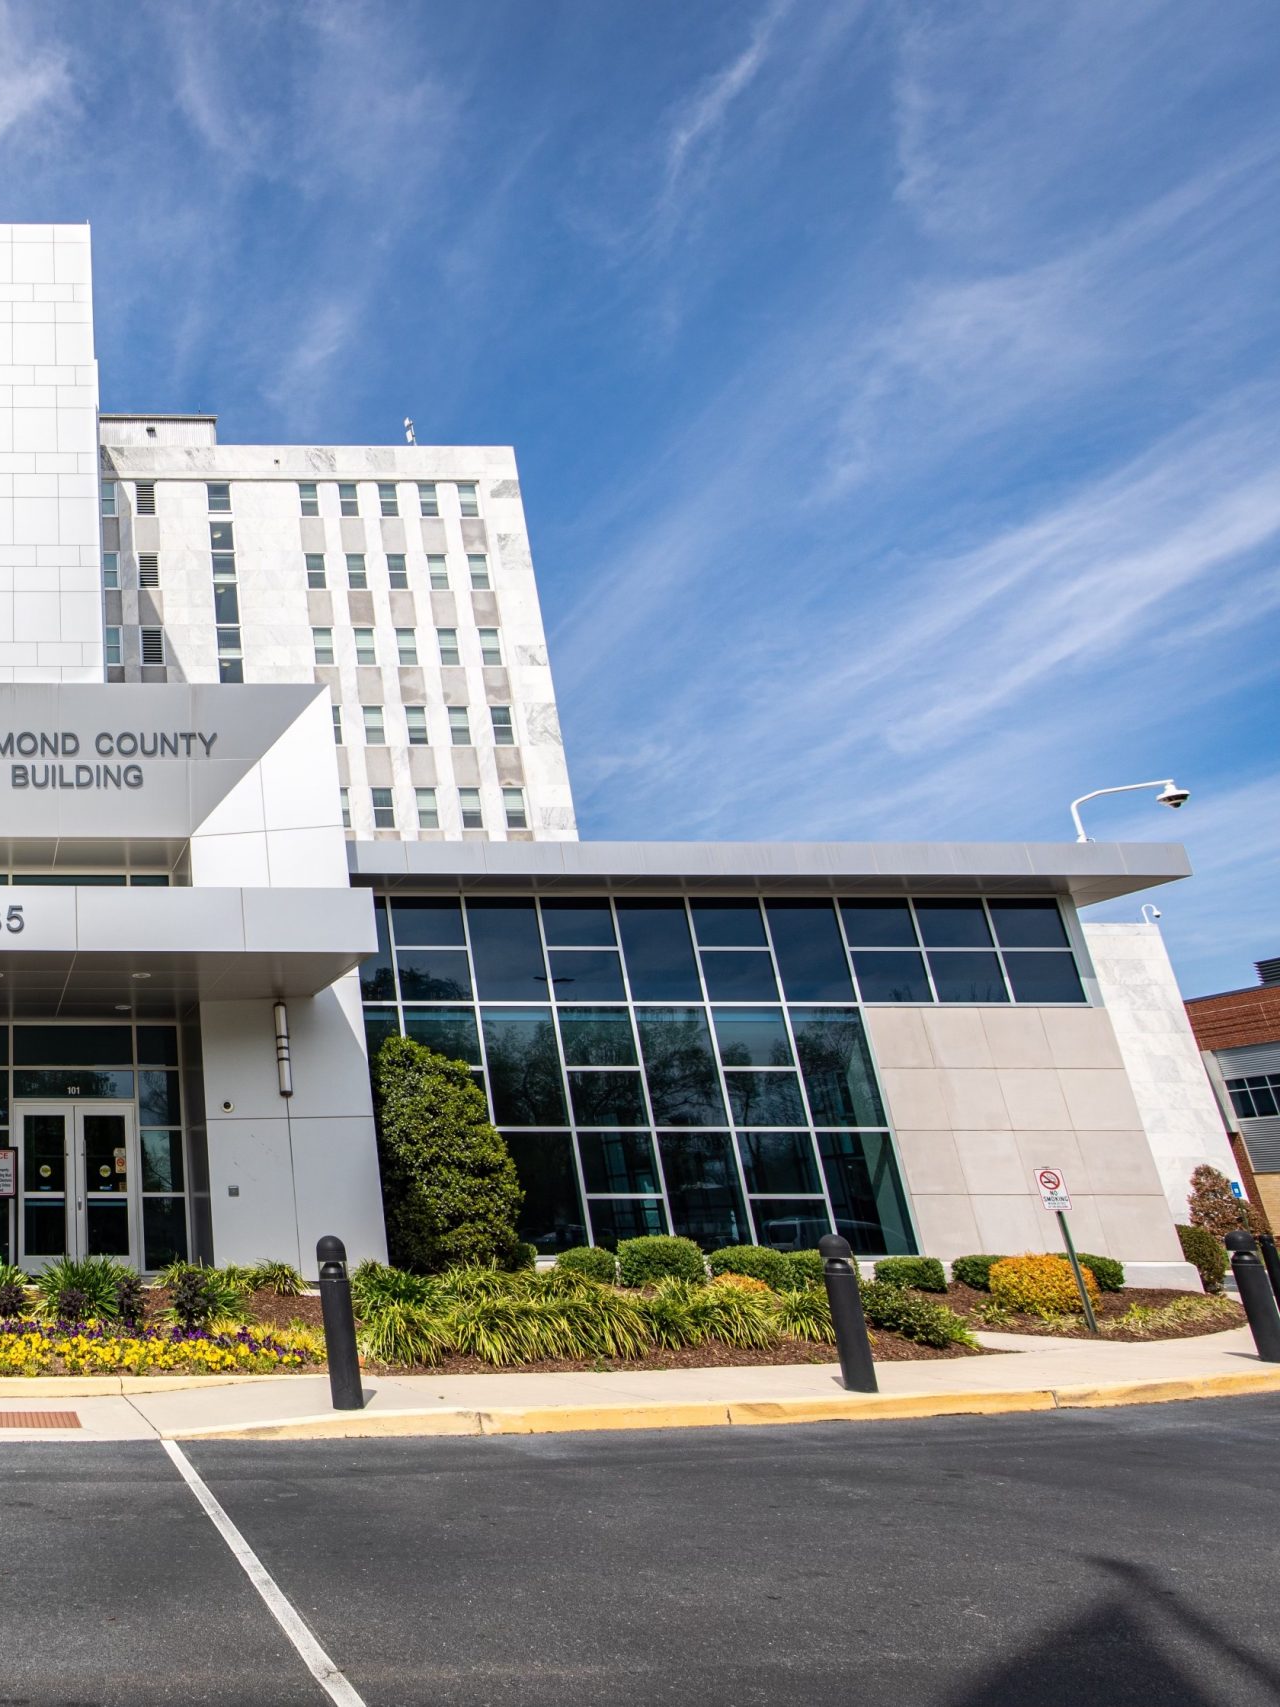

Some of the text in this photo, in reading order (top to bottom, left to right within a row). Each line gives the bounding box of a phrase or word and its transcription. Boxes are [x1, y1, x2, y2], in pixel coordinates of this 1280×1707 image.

[95, 731, 218, 757] COUNTY
[11, 764, 145, 790] BUILDING
[67, 1086, 80, 1095] 101
